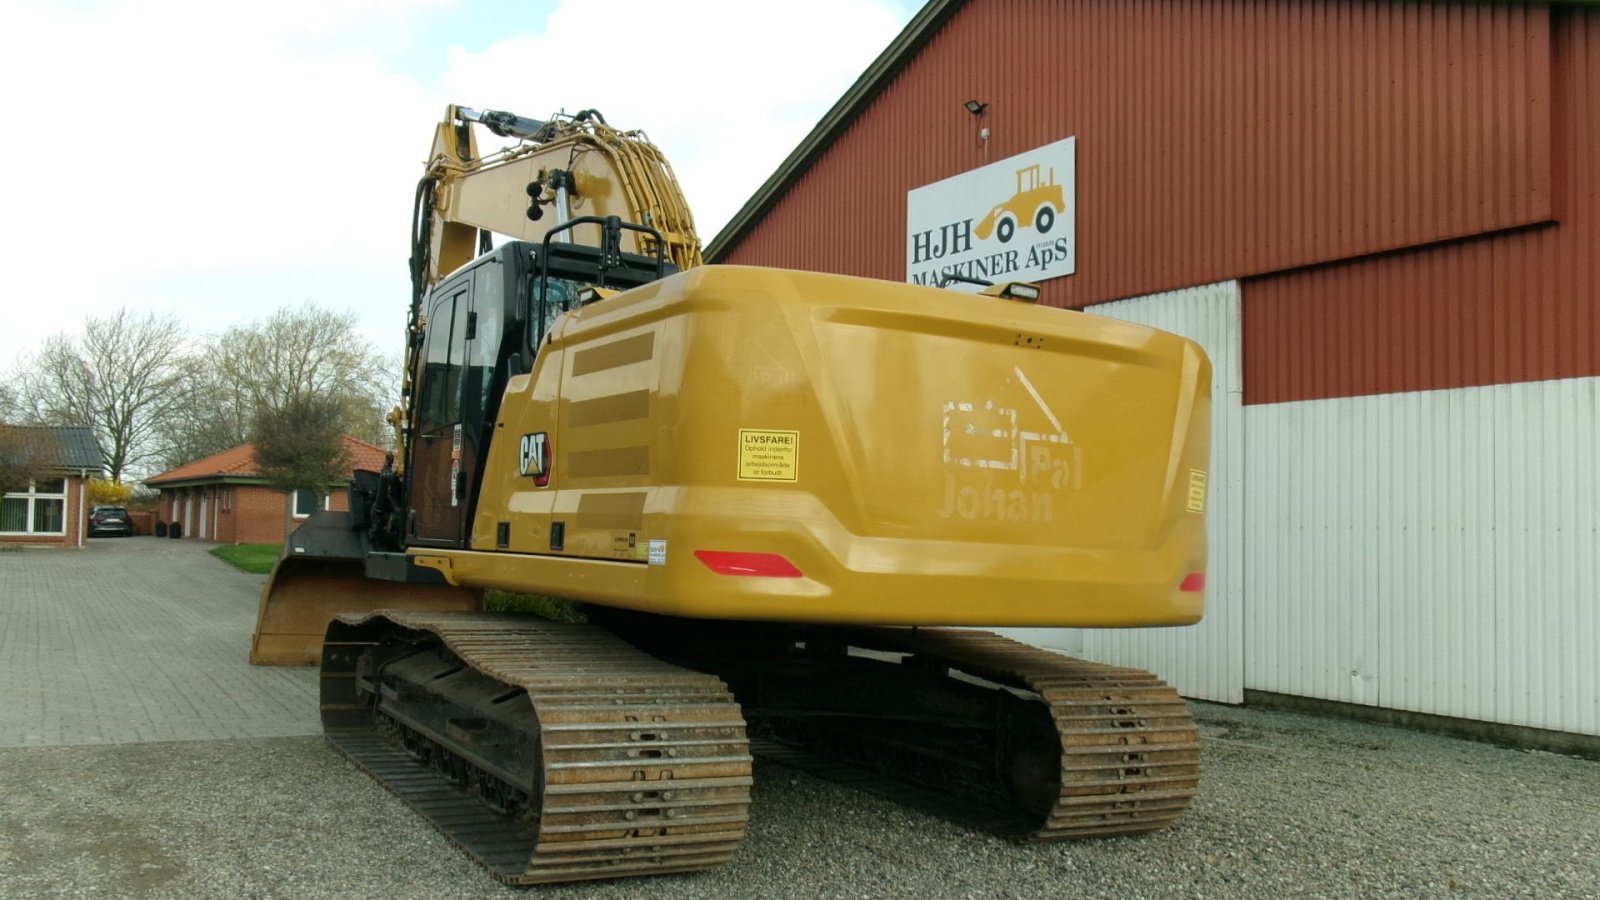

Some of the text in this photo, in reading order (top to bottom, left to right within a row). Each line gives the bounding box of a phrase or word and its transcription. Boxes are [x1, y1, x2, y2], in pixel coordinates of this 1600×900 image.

[912, 218, 973, 264] HJH
[912, 236, 1068, 287] MASKINER ApS
[520, 433, 545, 476] CAT
[745, 435, 793, 445] LIVSFARE!
